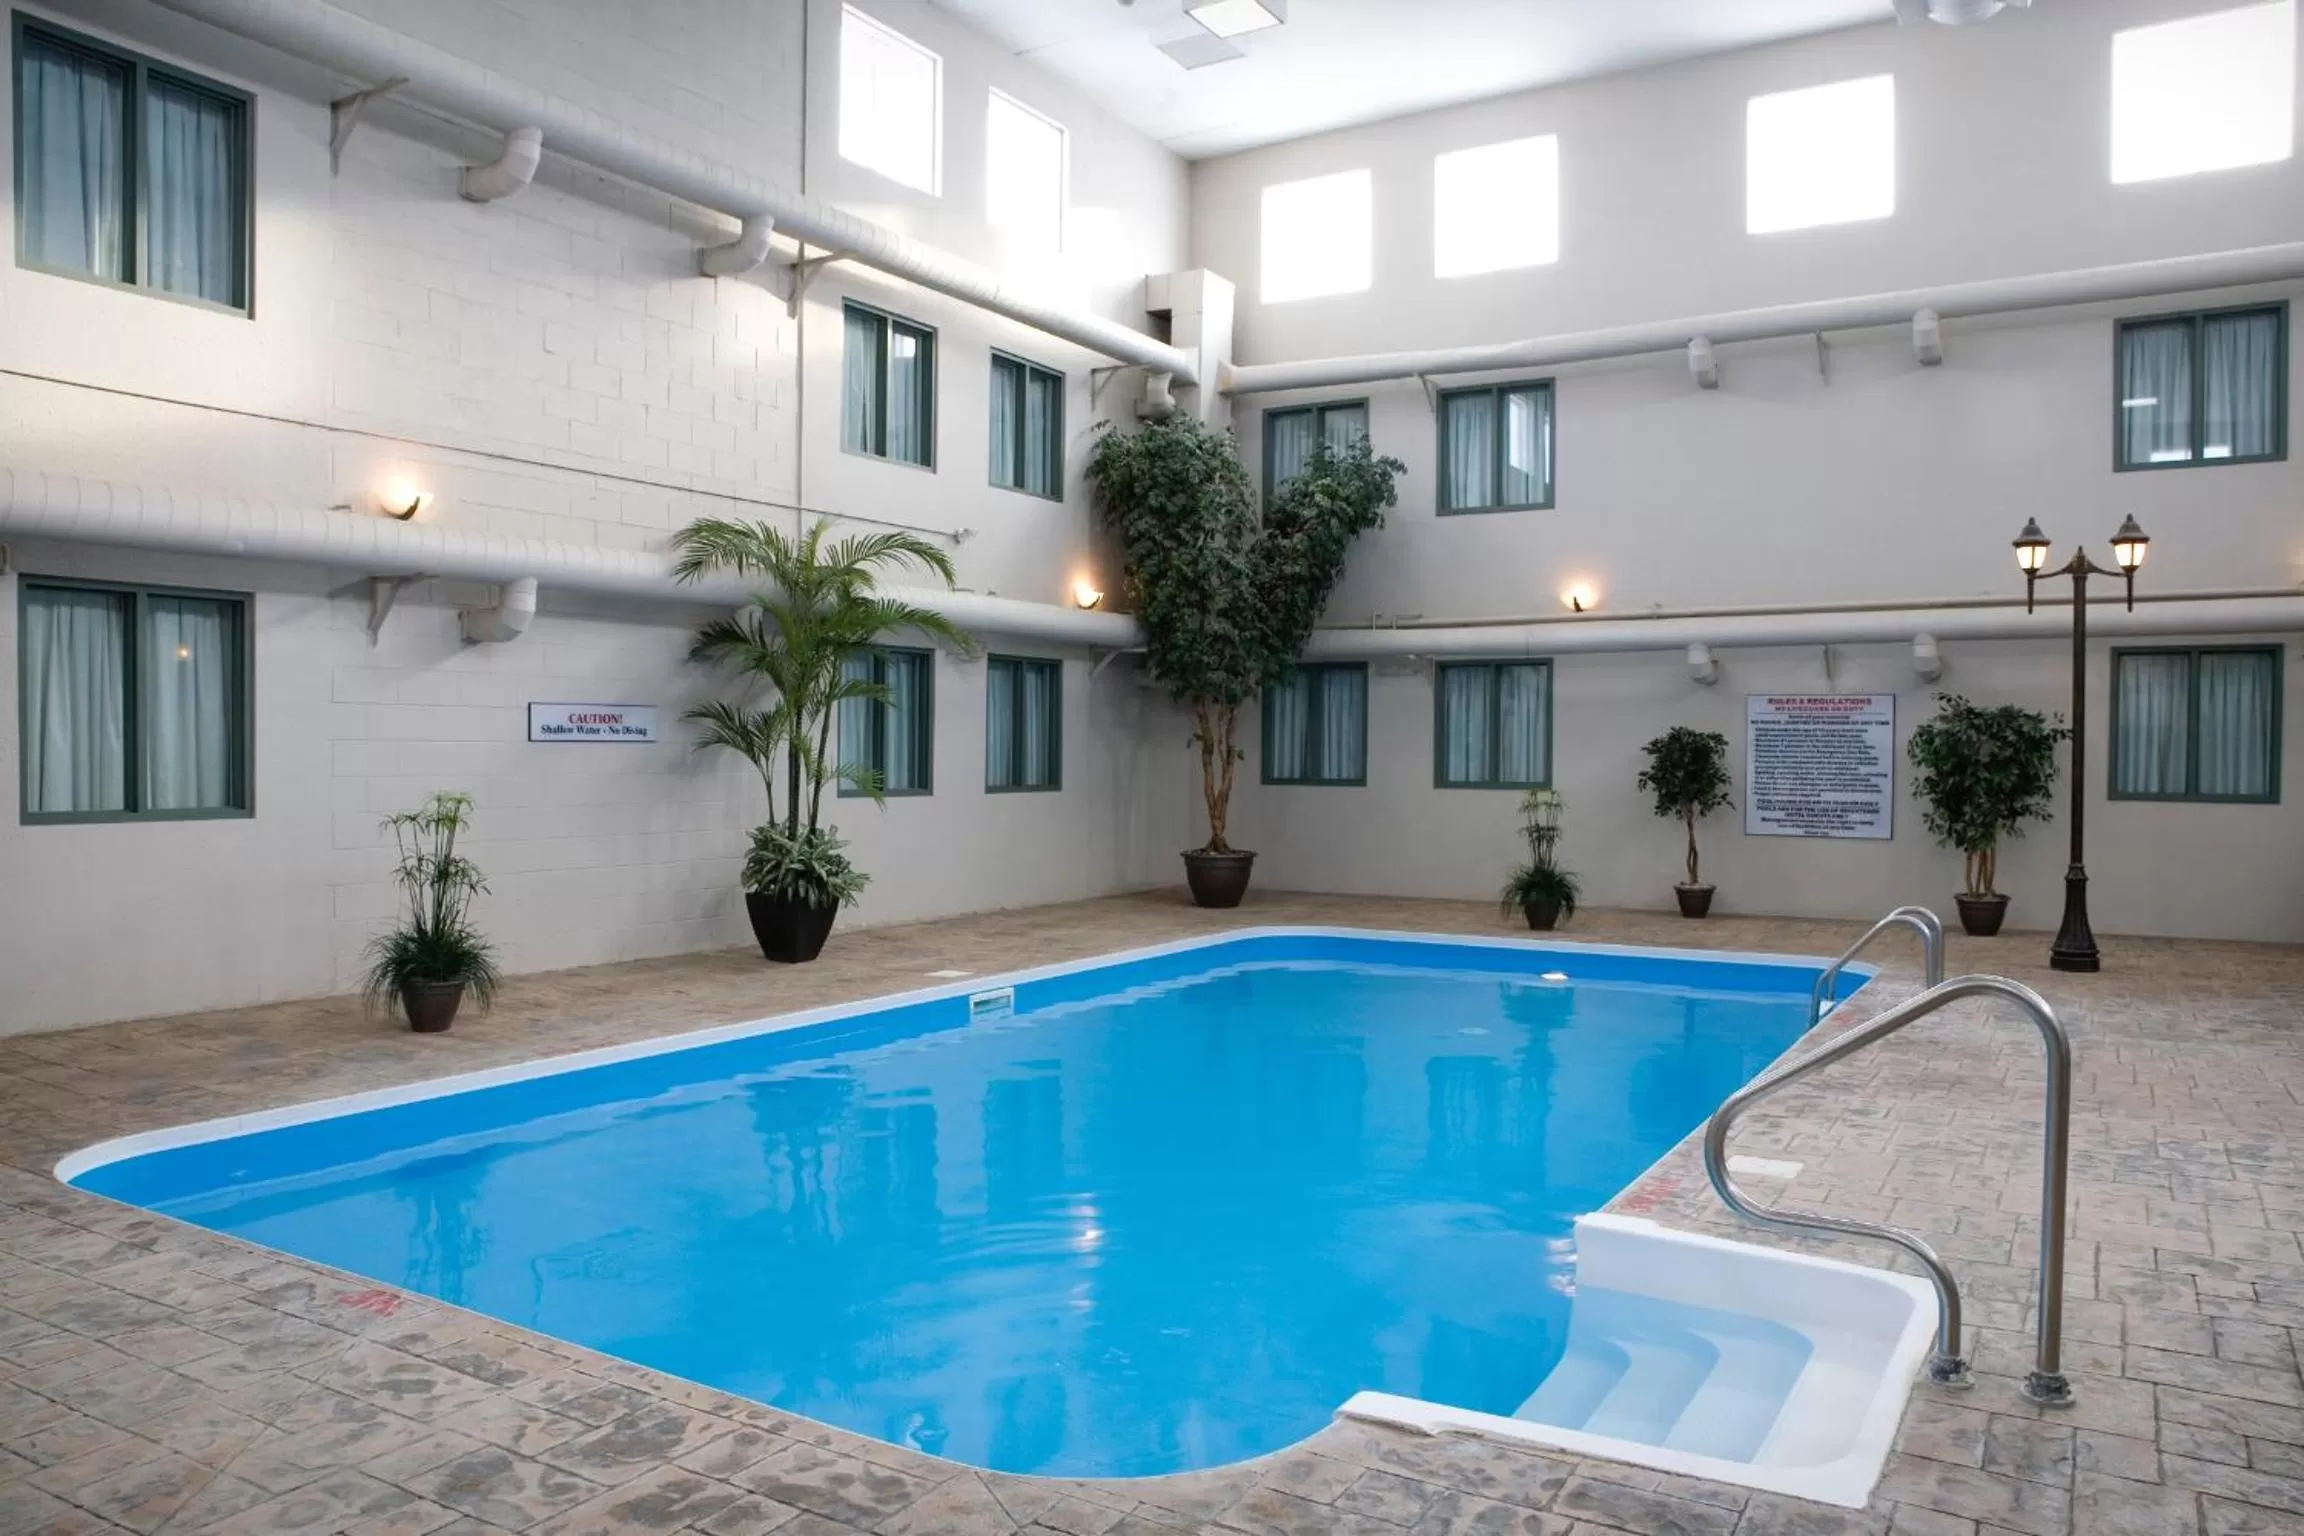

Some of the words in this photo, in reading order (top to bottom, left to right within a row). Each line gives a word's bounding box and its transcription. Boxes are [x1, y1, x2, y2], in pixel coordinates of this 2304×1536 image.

[1767, 697, 1797, 705] RULES
[1806, 697, 1872, 705] REGULATIONS
[567, 713, 624, 725] CAUTION!
[540, 724, 574, 735] Shallow
[575, 724, 601, 735] Water
[607, 725, 620, 735] No
[621, 726, 648, 738] Diving
